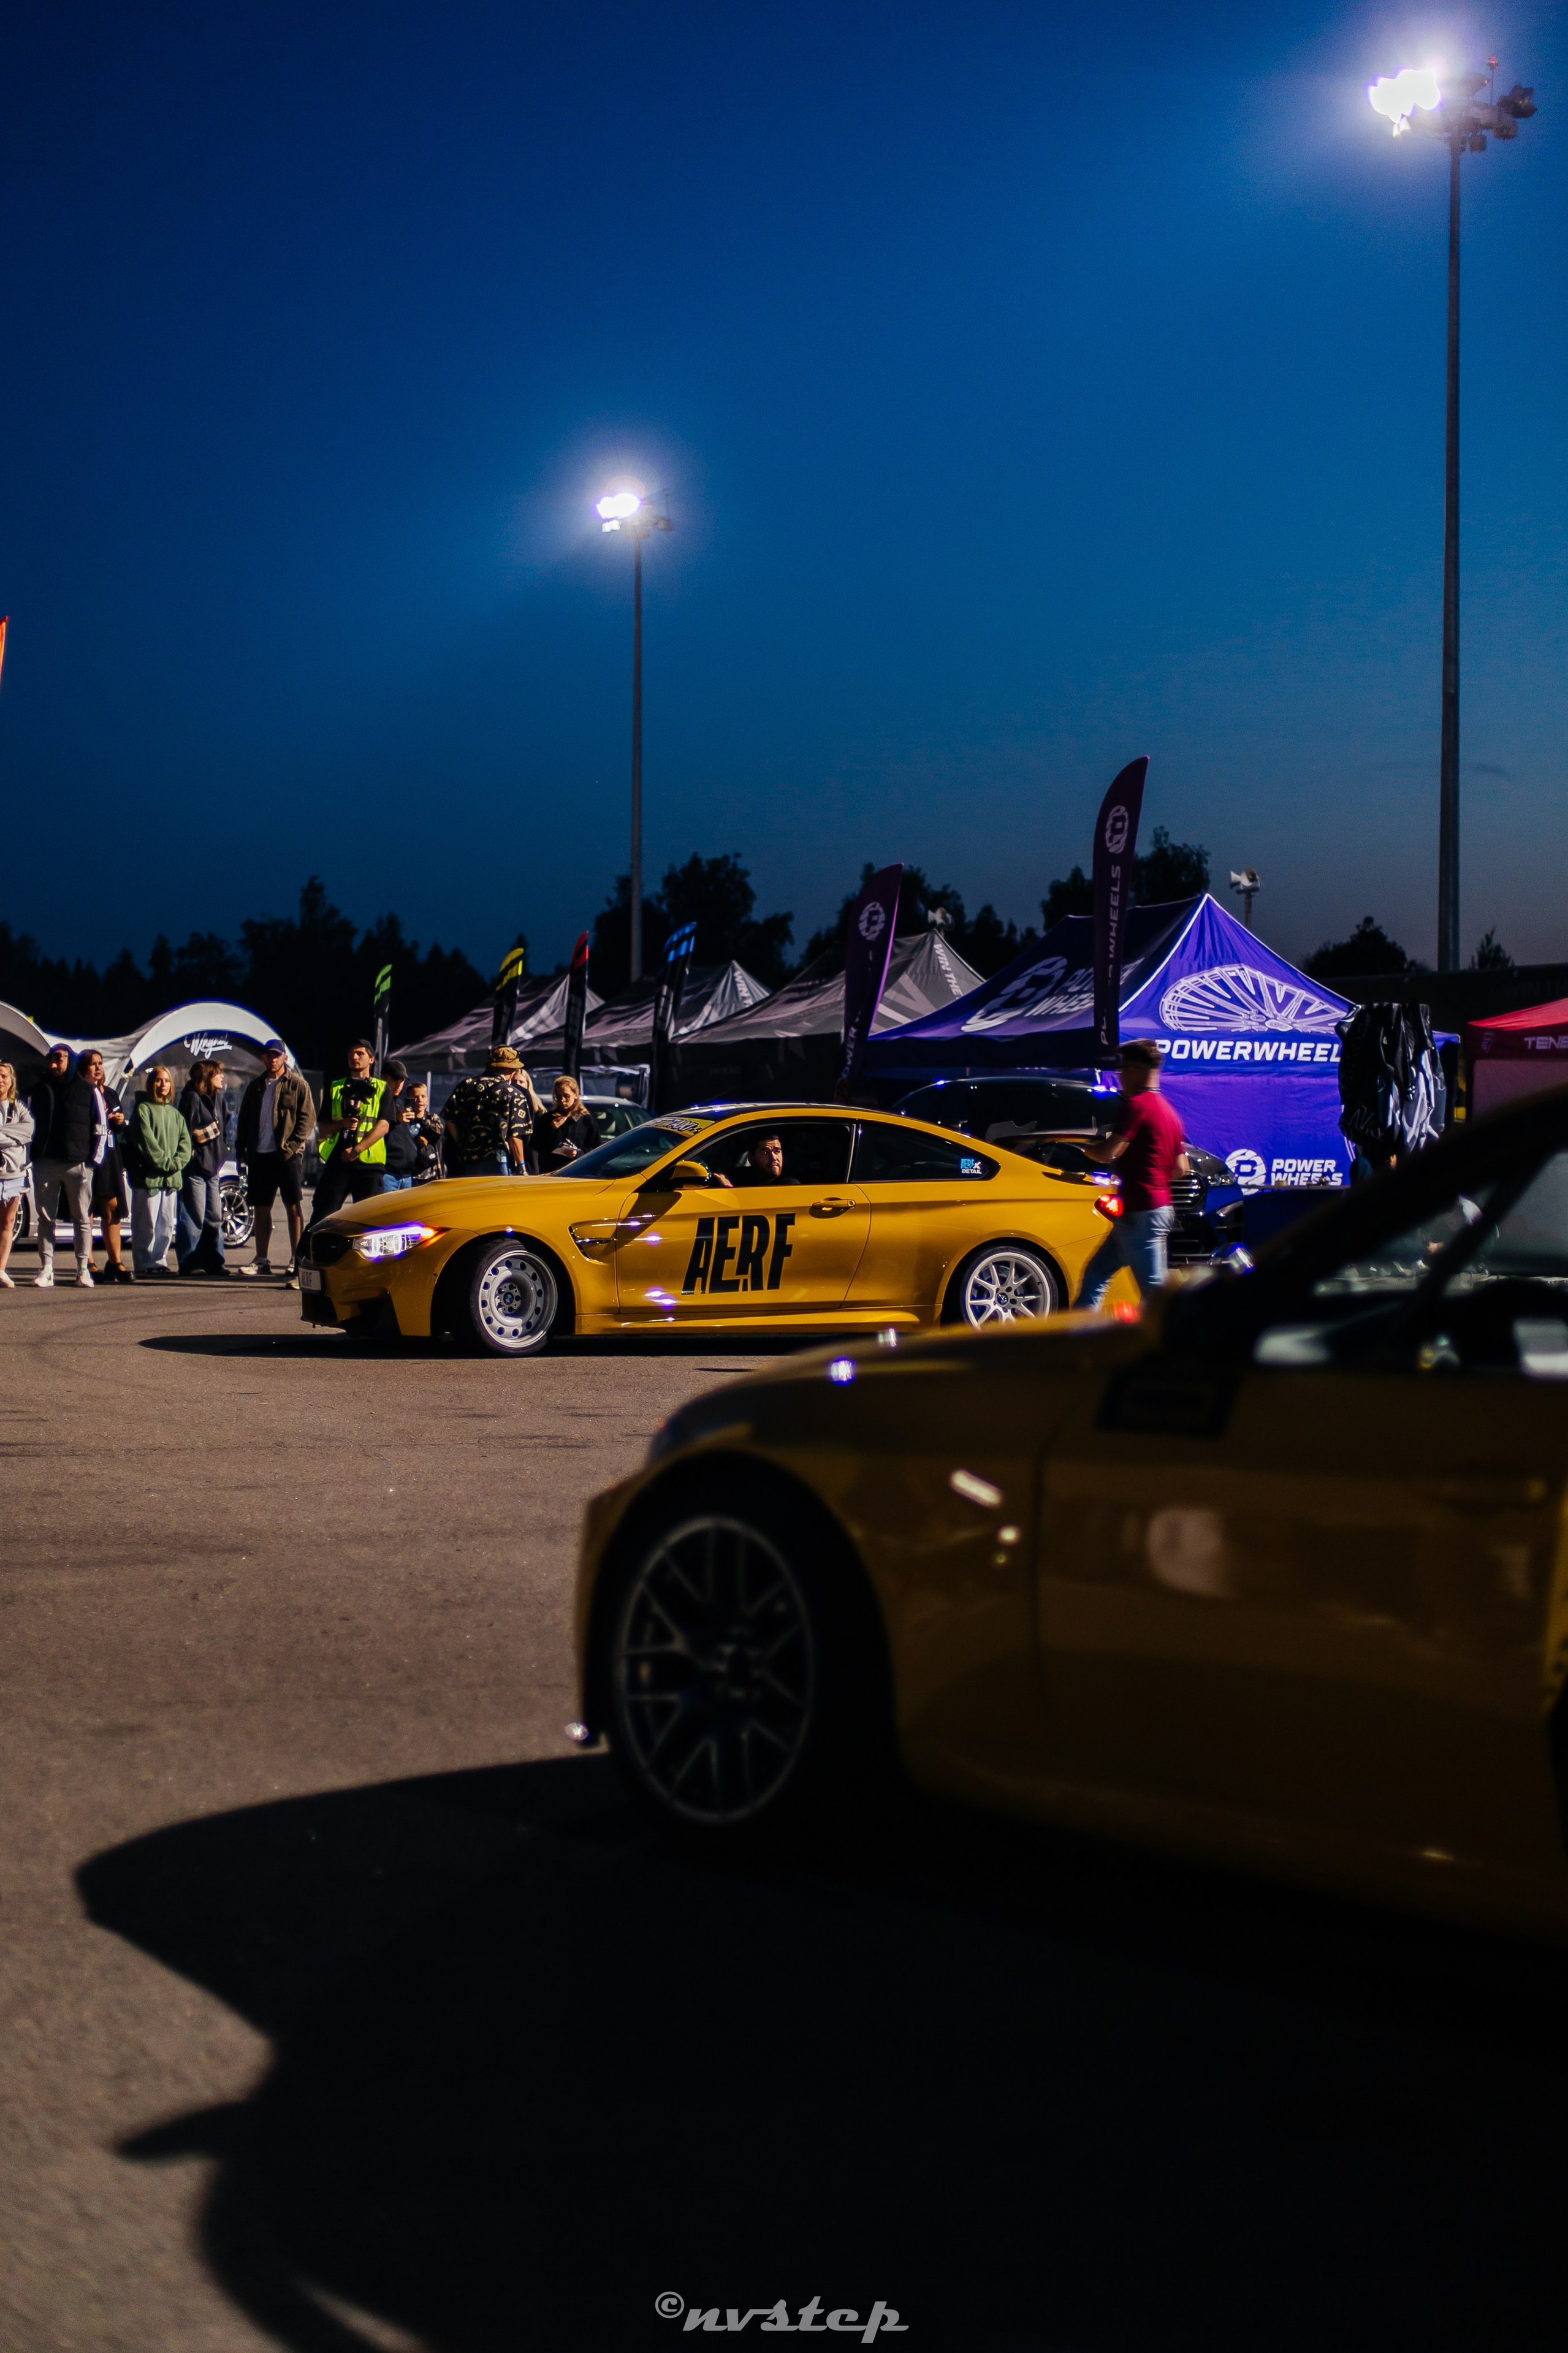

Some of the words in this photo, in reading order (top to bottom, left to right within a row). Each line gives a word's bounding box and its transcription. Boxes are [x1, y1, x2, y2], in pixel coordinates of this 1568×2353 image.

[1109, 865, 1121, 959] WHEELS
[841, 1027, 858, 1078] OWER
[1155, 1040, 1341, 1062] POWERWHEEL
[1271, 1158, 1336, 1173] POWER
[1271, 1173, 1343, 1186] WHEES
[681, 1213, 796, 1296] AERF
